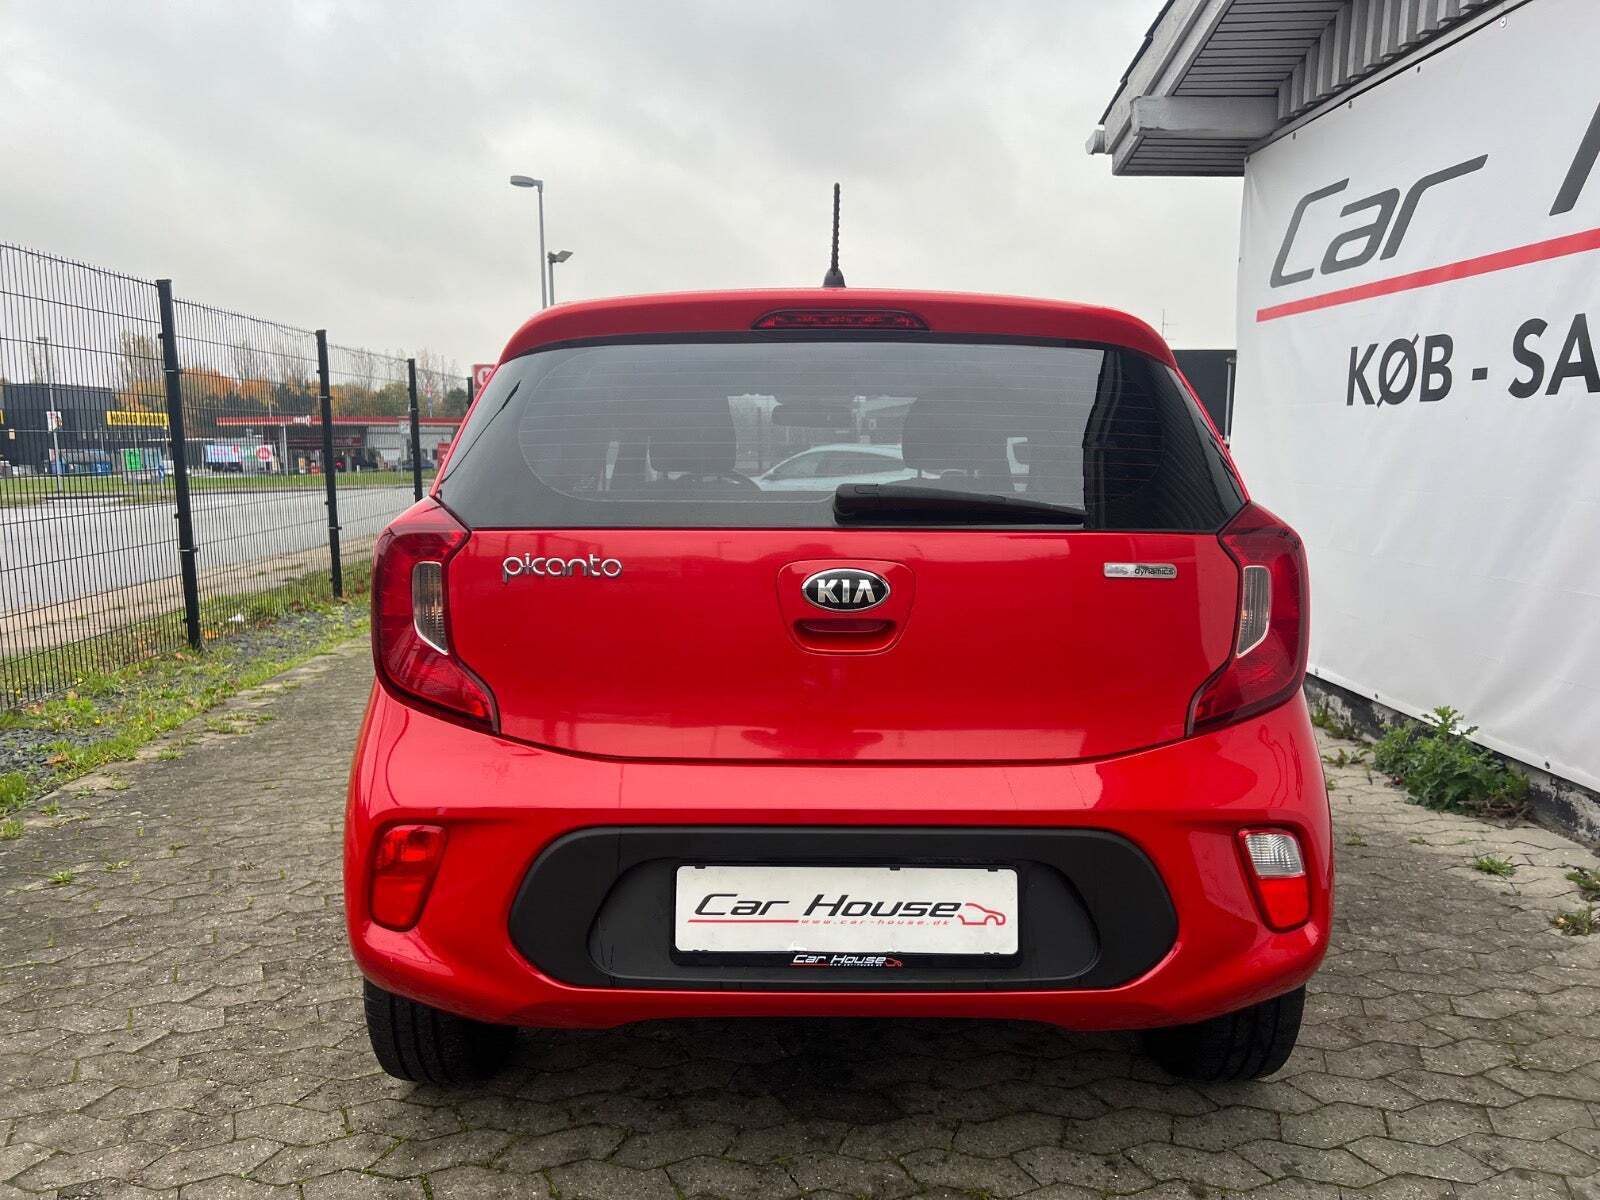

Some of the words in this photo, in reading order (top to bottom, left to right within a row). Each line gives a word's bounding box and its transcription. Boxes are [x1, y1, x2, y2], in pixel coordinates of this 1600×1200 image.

[1269, 153, 1489, 289] Car
[1346, 333, 1454, 408] KØB
[1507, 312, 1600, 399] SA
[503, 552, 623, 584] picanto
[1134, 565, 1175, 576] dynamics
[816, 579, 876, 603] KIA
[694, 893, 791, 916] Car
[803, 894, 962, 917] House
[801, 918, 951, 926] www.car-house.dk
[793, 954, 827, 963] Car
[830, 954, 887, 964] House
